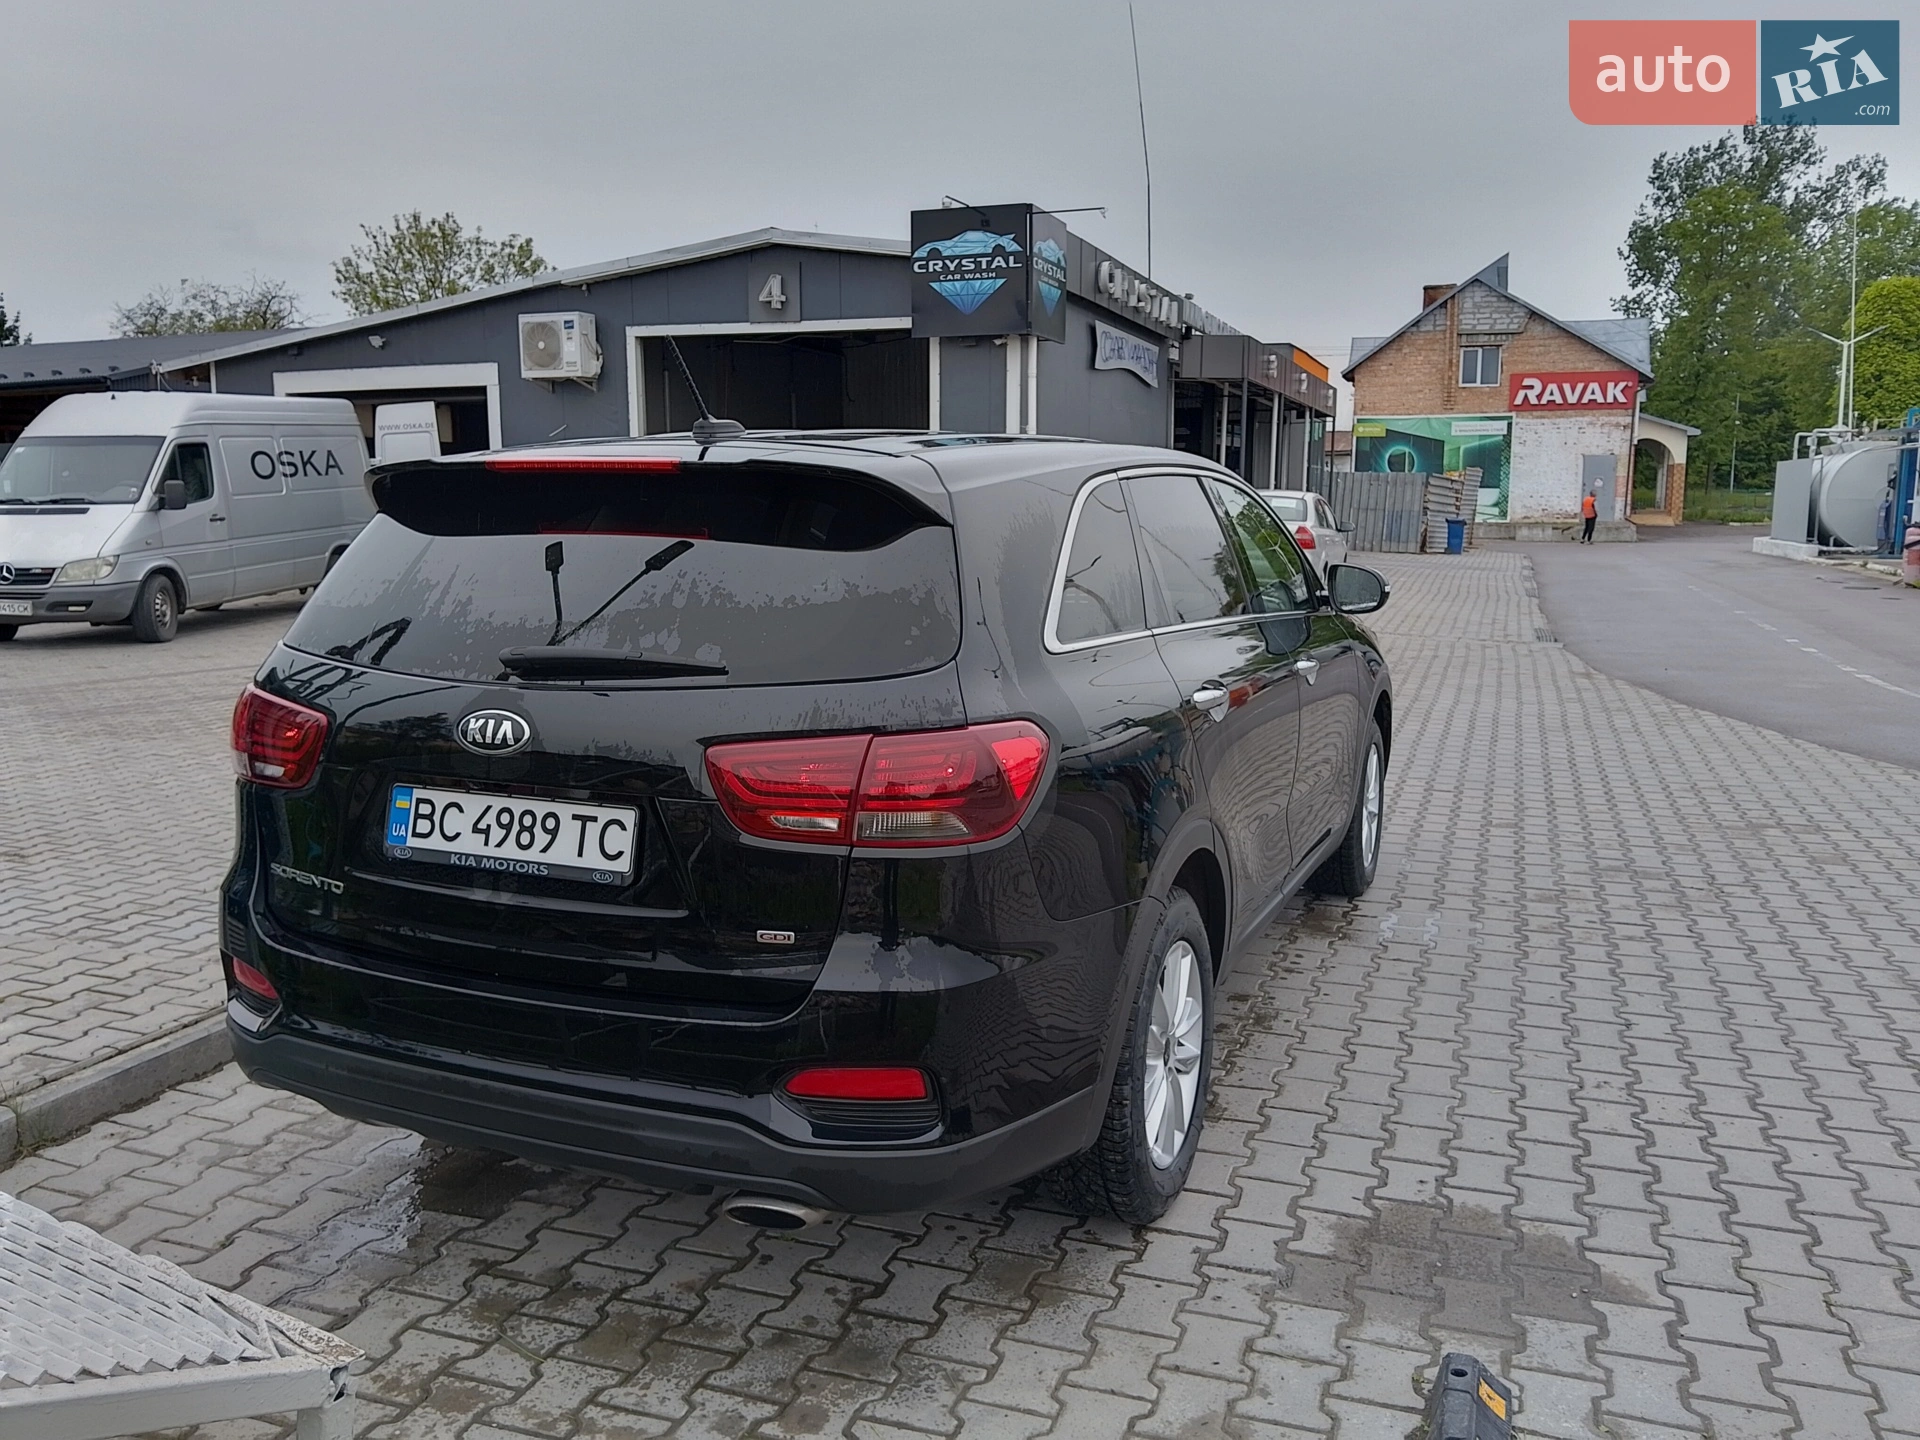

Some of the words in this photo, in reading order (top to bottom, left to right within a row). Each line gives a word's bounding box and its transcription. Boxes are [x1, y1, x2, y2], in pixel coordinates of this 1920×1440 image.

[913, 255, 1023, 273] CRYSTAL
[964, 271, 996, 279] WASH
[1032, 257, 1067, 283] CRYSTAL
[758, 273, 786, 309] 4
[1513, 377, 1628, 405] RAVAK
[378, 421, 435, 431] WWW.OSKA.DE
[250, 450, 344, 480] OSKA
[0, 603, 16, 613] 415
[466, 717, 515, 746] KIA
[392, 823, 407, 838] UA
[411, 797, 465, 842] BC
[471, 804, 561, 854] 4989
[571, 813, 628, 861] TC
[396, 847, 410, 857] KIA
[451, 853, 477, 868] KIA
[480, 858, 549, 876] MOTORS
[270, 862, 345, 895] SORENTO
[595, 871, 613, 882] KIA
[760, 933, 791, 942] GDI
